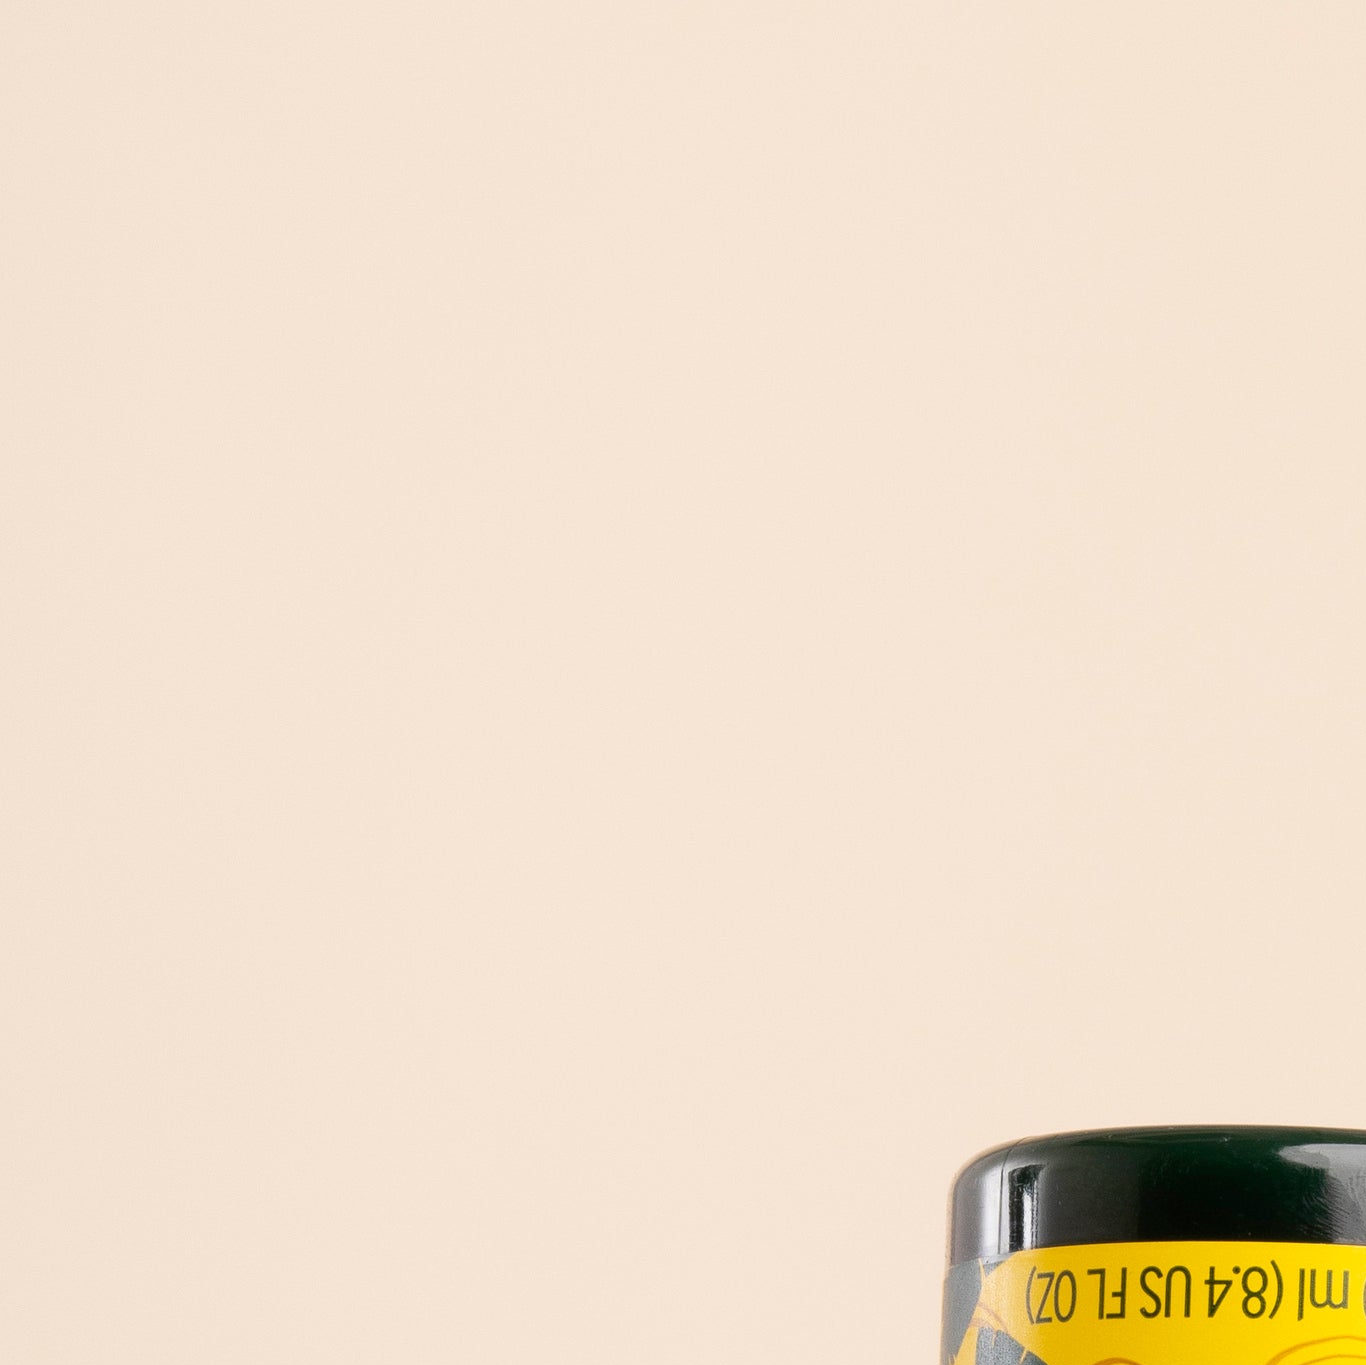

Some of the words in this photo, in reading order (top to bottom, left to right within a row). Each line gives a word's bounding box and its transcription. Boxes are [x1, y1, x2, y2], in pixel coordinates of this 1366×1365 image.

[1025, 1266, 1078, 1325] OZ)
[1086, 1266, 1128, 1320] FL
[1139, 1265, 1192, 1319] US
[1204, 1259, 1284, 1320] (8.4
[1297, 1268, 1350, 1322] ml
